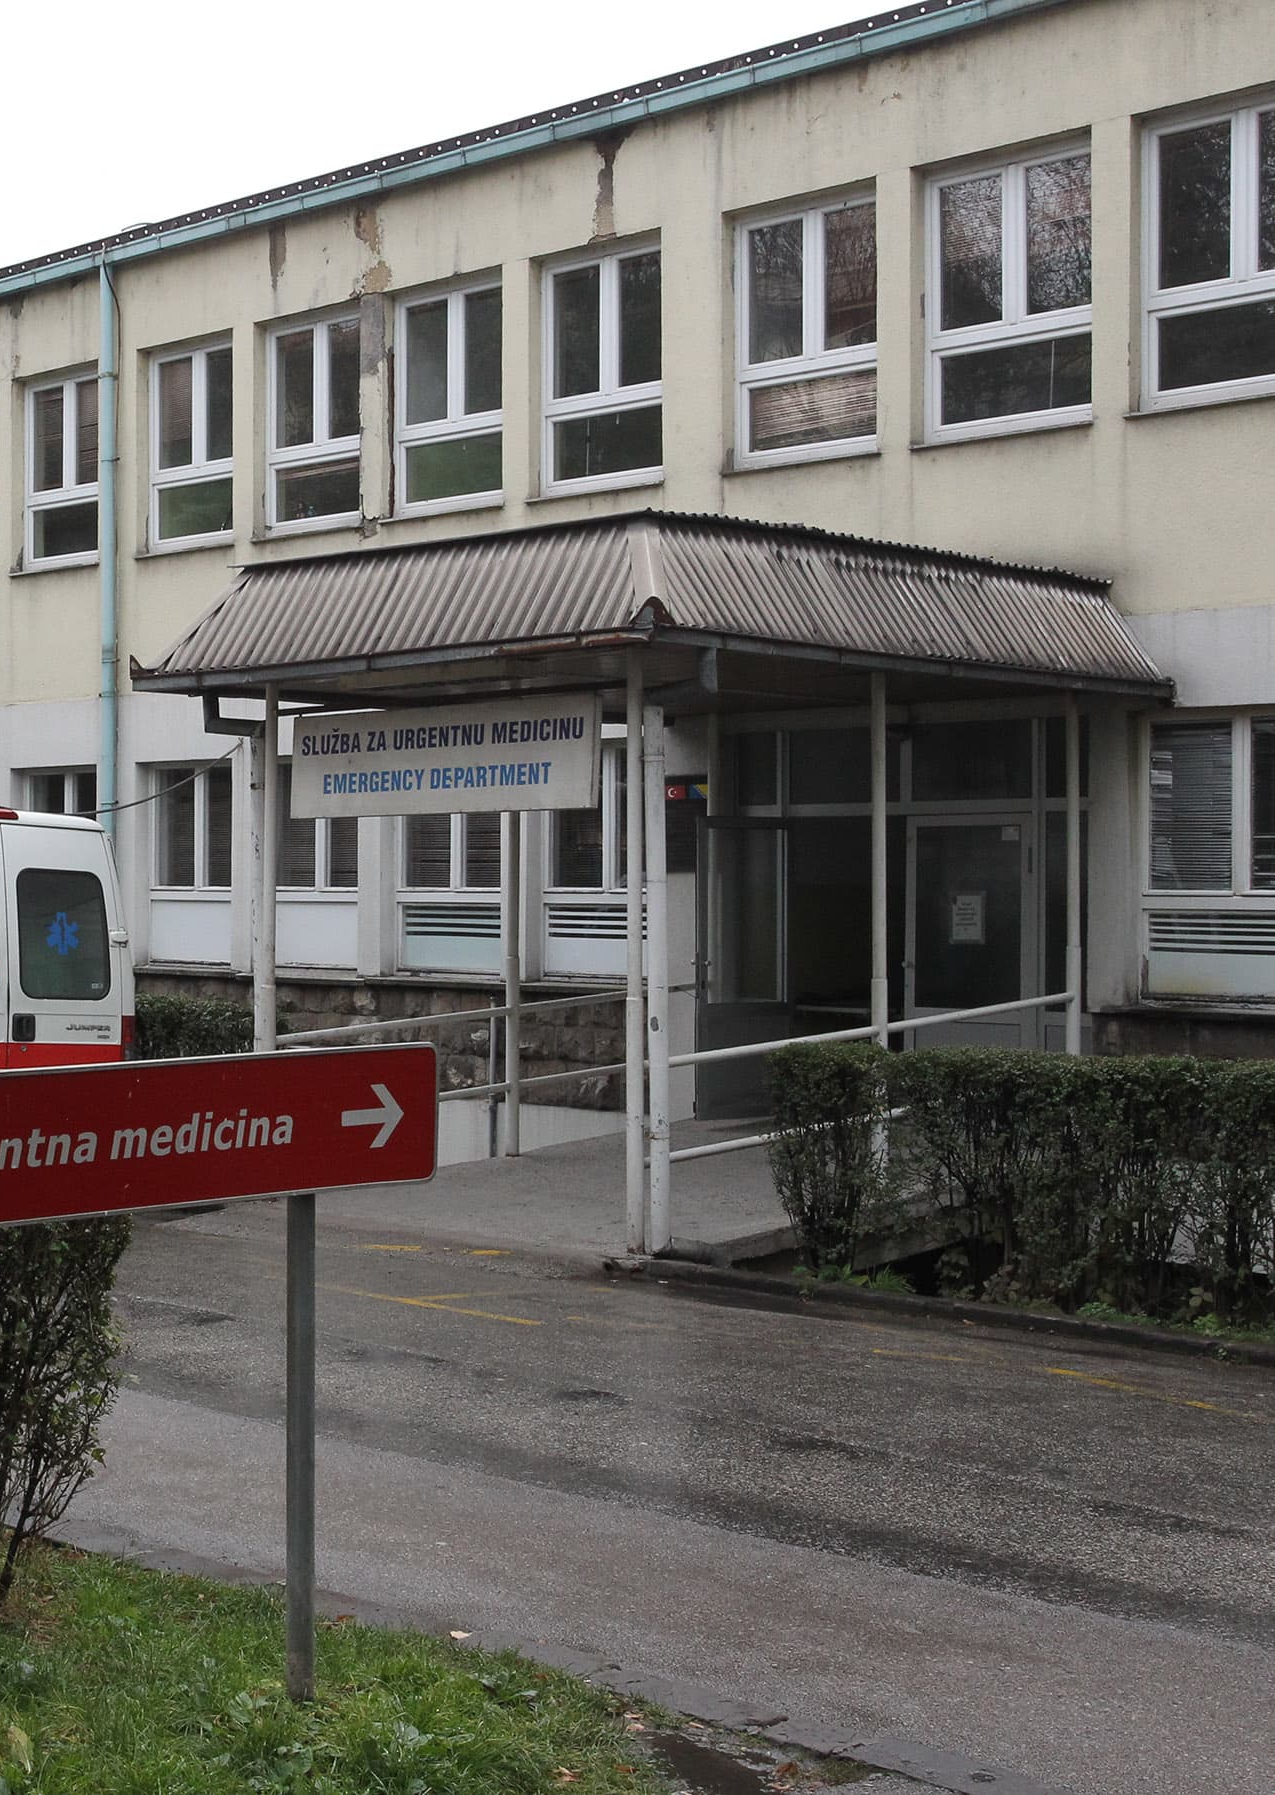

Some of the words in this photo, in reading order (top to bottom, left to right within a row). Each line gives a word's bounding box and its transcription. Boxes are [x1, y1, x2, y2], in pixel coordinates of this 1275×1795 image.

[301, 728, 361, 756] SLUŽBA
[367, 729, 387, 751] ZA
[393, 723, 485, 750] URGENTNU
[491, 716, 585, 745] MEDICINU
[323, 768, 424, 795] EMERGENCY
[429, 761, 552, 789] DEPARTMENT
[109, 1108, 294, 1160] medicina
